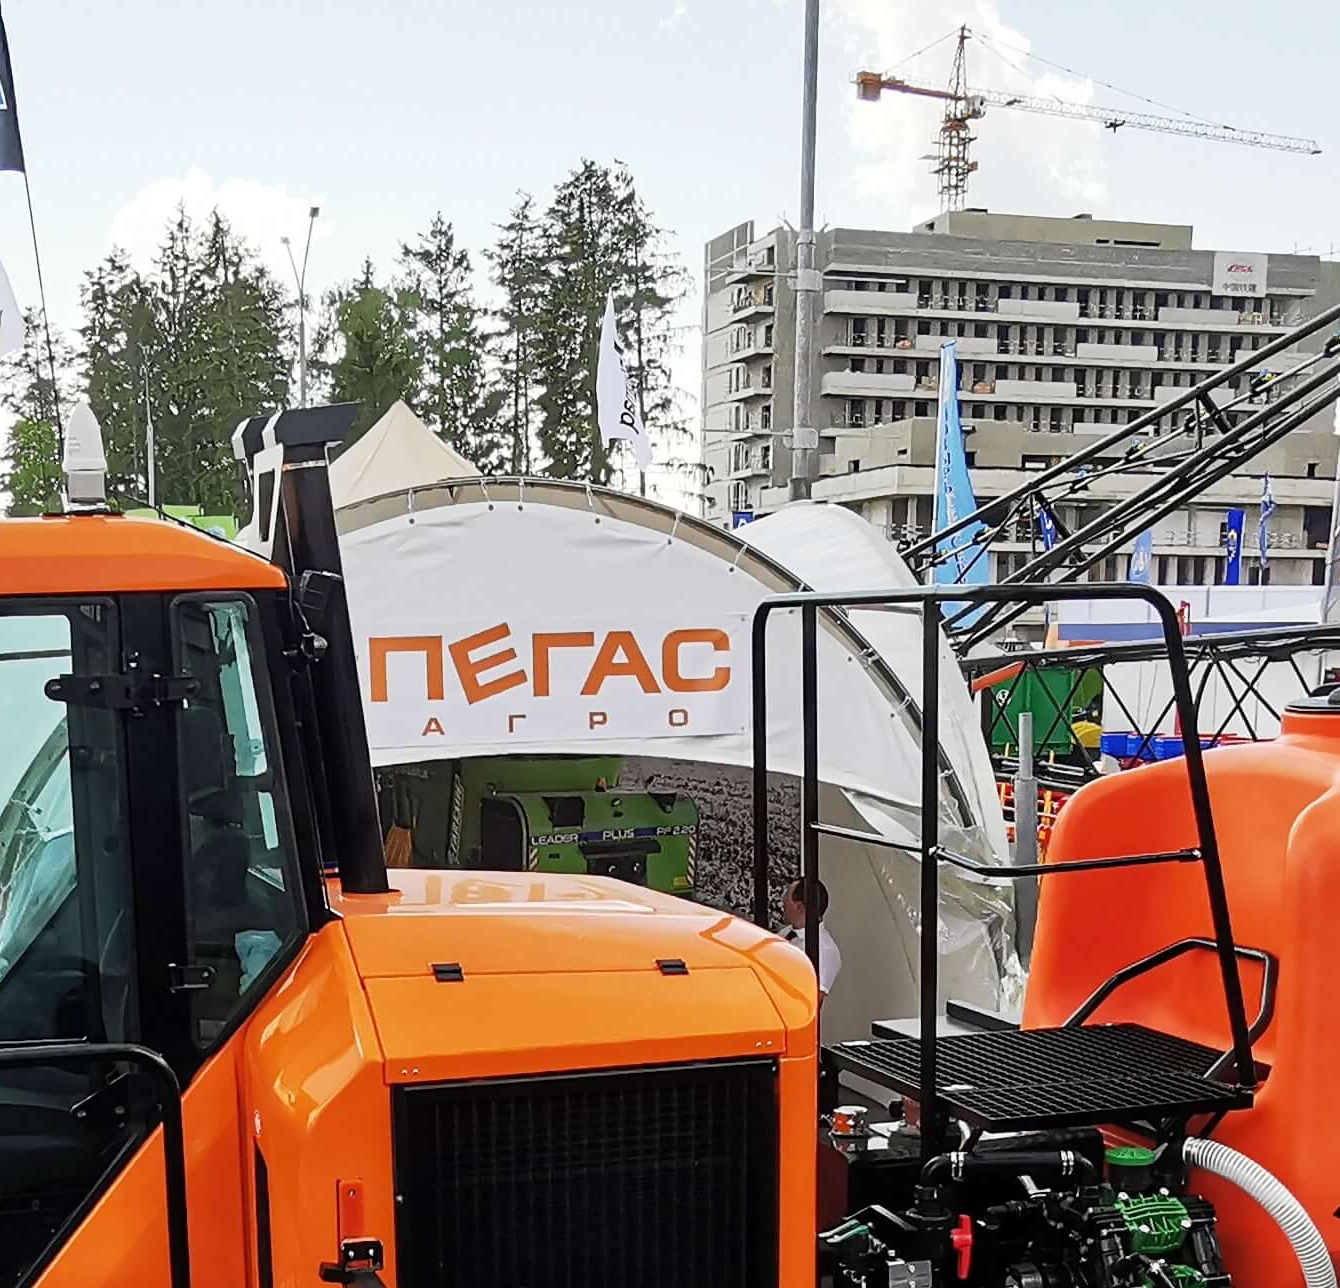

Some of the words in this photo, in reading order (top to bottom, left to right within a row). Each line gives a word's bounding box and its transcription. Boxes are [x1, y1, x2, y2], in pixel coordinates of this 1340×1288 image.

[369, 622, 731, 705] ПЕГАС
[422, 708, 689, 736] АГРО
[531, 833, 578, 846] LEADER
[602, 828, 635, 841] PLUS
